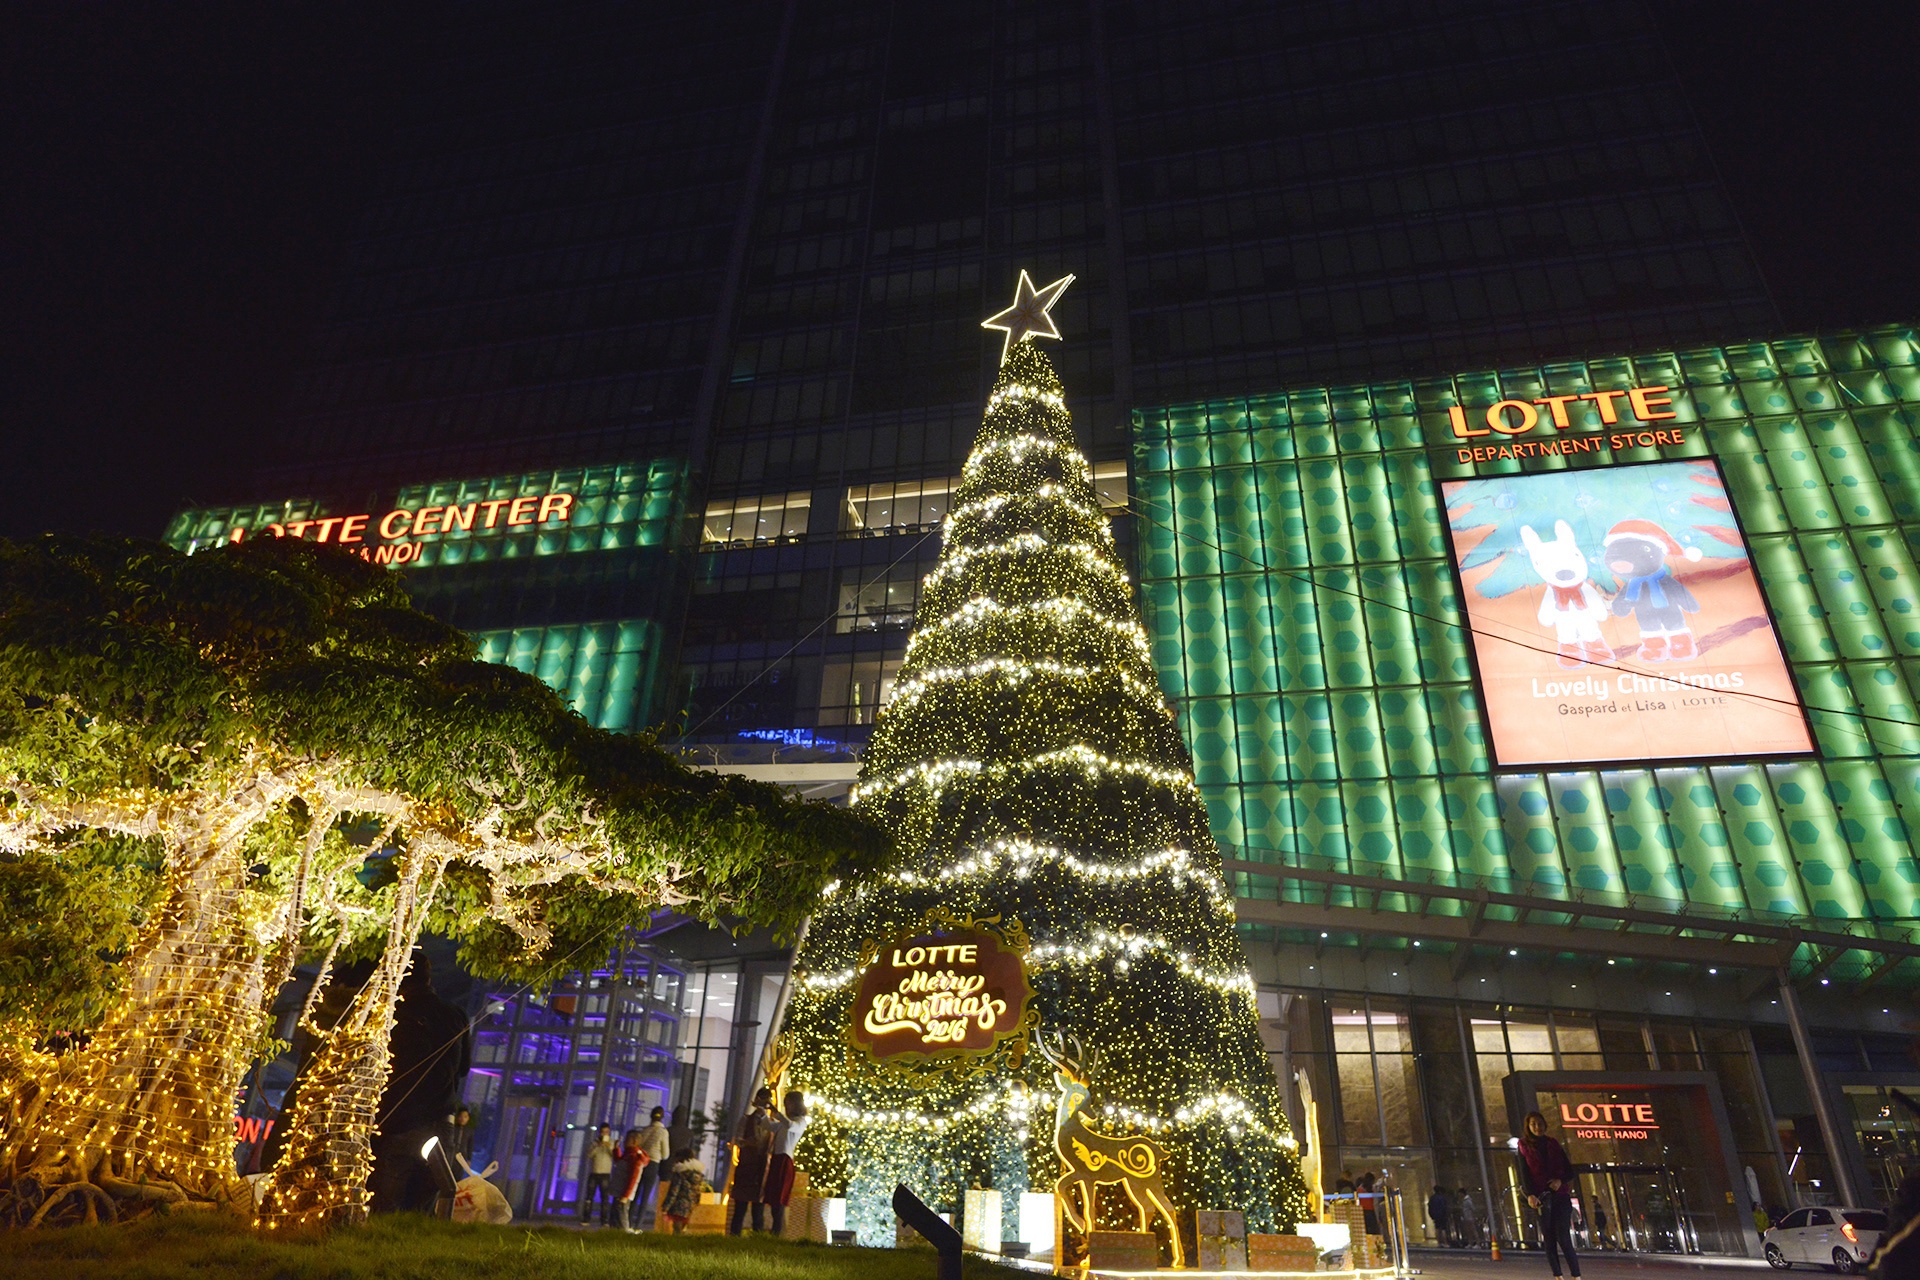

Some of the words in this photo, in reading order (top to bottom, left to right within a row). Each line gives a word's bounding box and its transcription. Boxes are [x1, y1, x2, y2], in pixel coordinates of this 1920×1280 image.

[1448, 385, 1677, 438] LOTTE
[1457, 436, 1603, 464] DEPARTMENT
[1611, 429, 1686, 451] STORE
[378, 493, 575, 540] CENTER
[1532, 675, 1609, 701] Lovely
[1617, 671, 1745, 695] Christmas
[1558, 700, 1617, 717] Gaspard
[1621, 704, 1632, 712] et
[1635, 699, 1666, 712] Lisa
[1682, 697, 1728, 706] LOTTE
[892, 944, 978, 968] LOTTE
[899, 970, 985, 998] Merry
[864, 992, 1007, 1034] Christmas
[921, 1016, 969, 1043] 2016
[1560, 1103, 1655, 1122] LOTTE
[1577, 1130, 1611, 1139] HOTEL
[1614, 1130, 1648, 1140] HANOI
